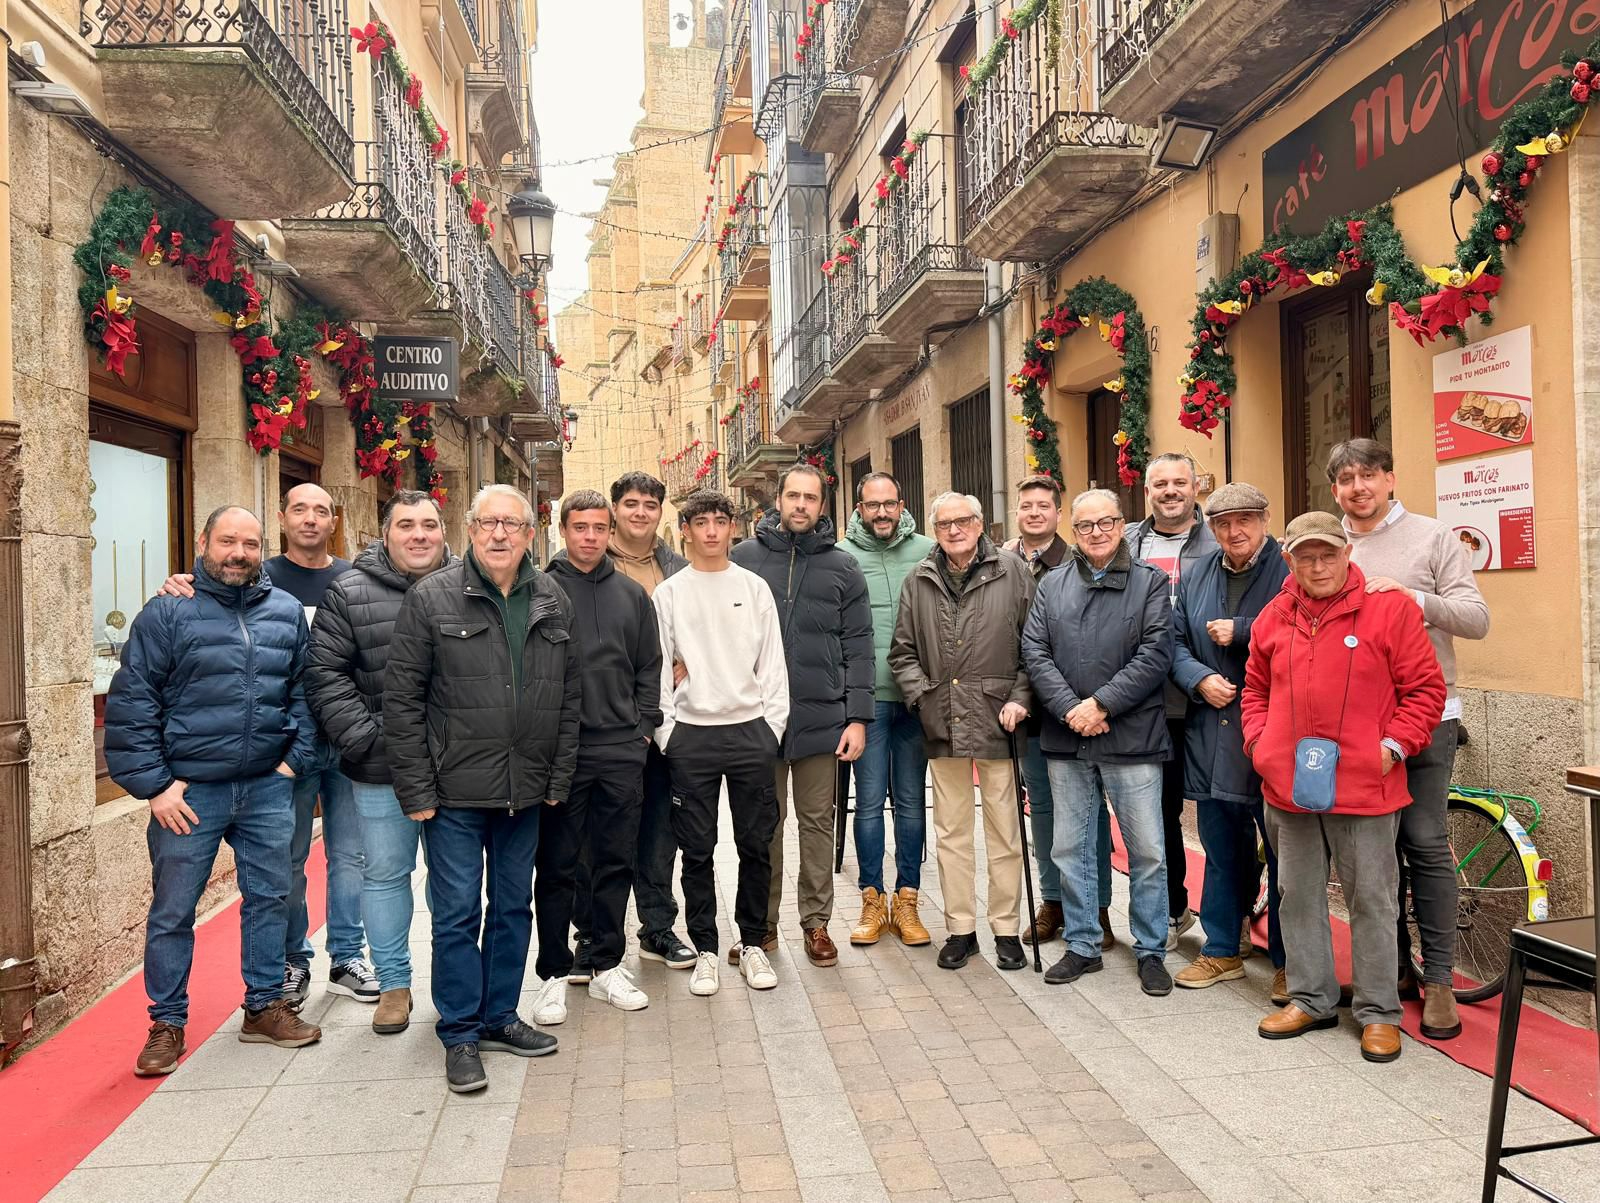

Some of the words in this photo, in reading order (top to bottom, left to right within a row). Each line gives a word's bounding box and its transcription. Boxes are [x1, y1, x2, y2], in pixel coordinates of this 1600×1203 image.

[386, 346, 443, 365] CENTRO
[380, 372, 449, 391] AUDITIVO
[1449, 374, 1463, 384] PIDE
[1464, 370, 1473, 379] TU
[1474, 360, 1511, 377] MONTADITO
[1438, 493, 1460, 502] HUEVOS
[1462, 489, 1482, 498] FRITOS
[1484, 487, 1497, 495] CON
[1498, 483, 1530, 494] FARINATO
[1500, 508, 1531, 516] INGREDIENTES
